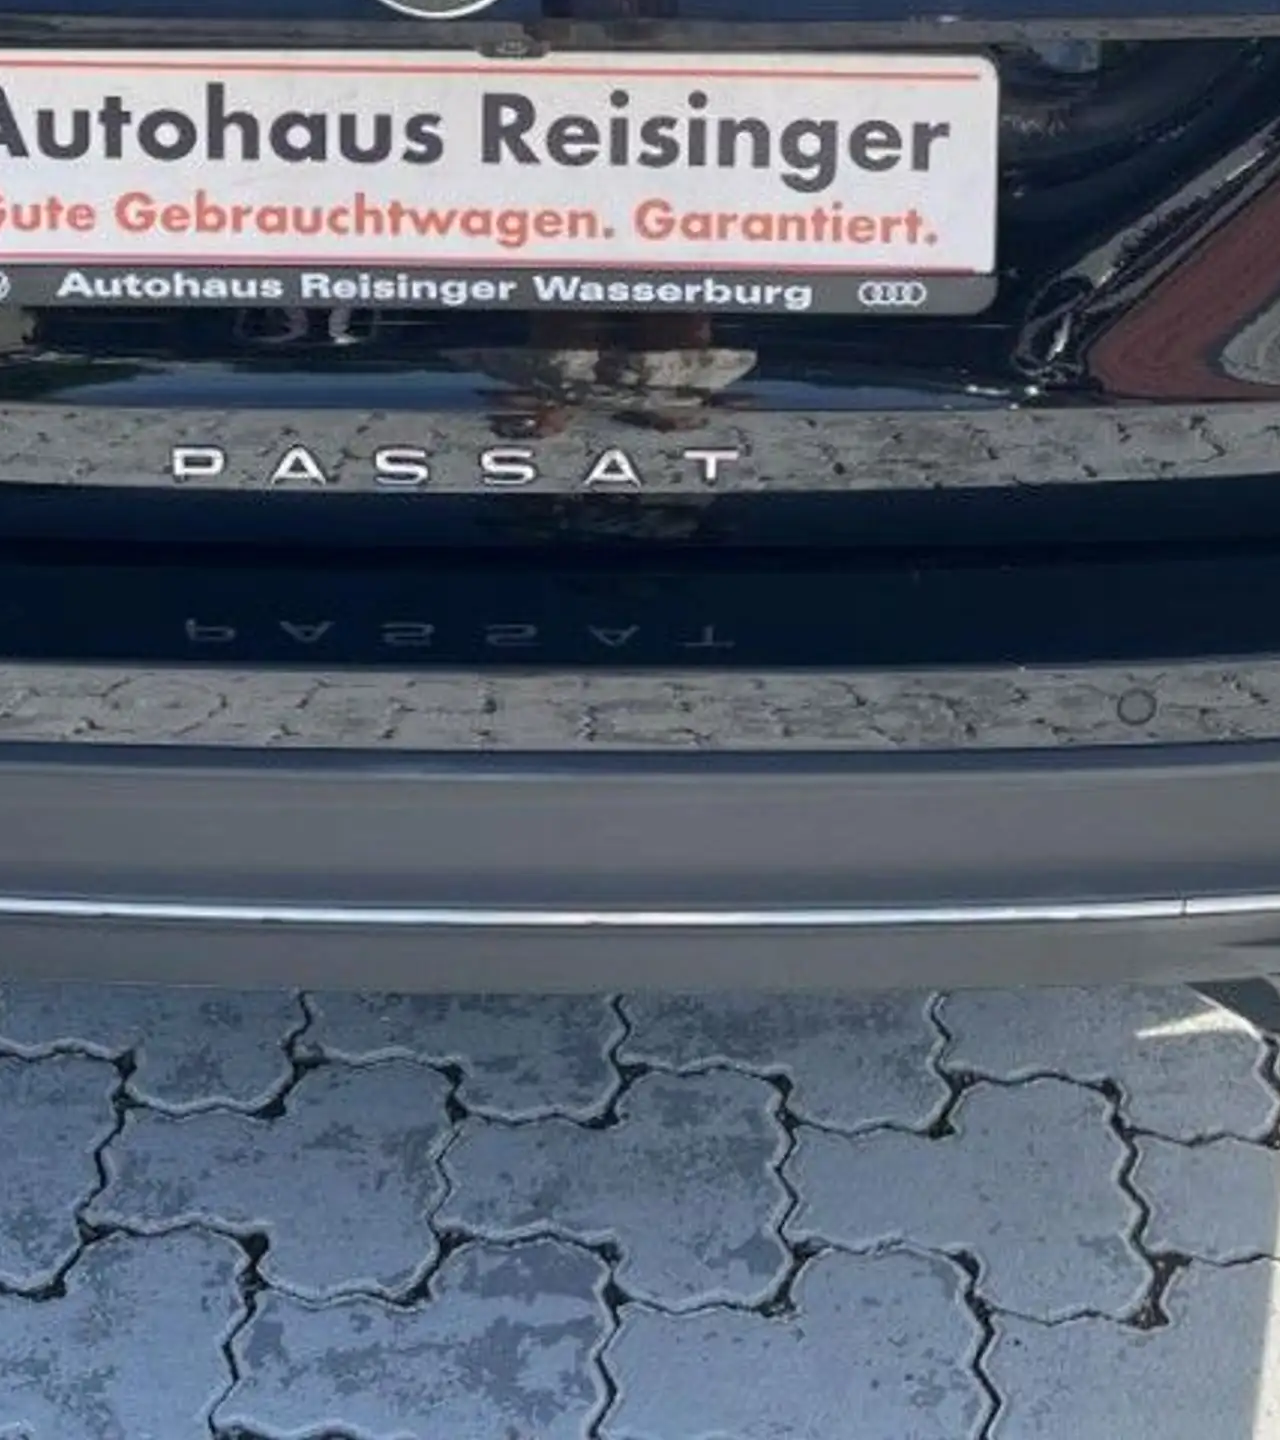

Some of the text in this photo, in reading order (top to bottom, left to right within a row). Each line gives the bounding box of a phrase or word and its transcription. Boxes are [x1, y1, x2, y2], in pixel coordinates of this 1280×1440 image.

[480, 89, 951, 194] Reisinger
[113, 189, 616, 248] Gebrauchtwagen.
[633, 198, 939, 246] Garantiert.
[56, 271, 285, 301] Autohaus
[300, 272, 518, 308] Reisinger
[532, 275, 814, 311] Wasserburg
[171, 445, 740, 486] PASSAT
